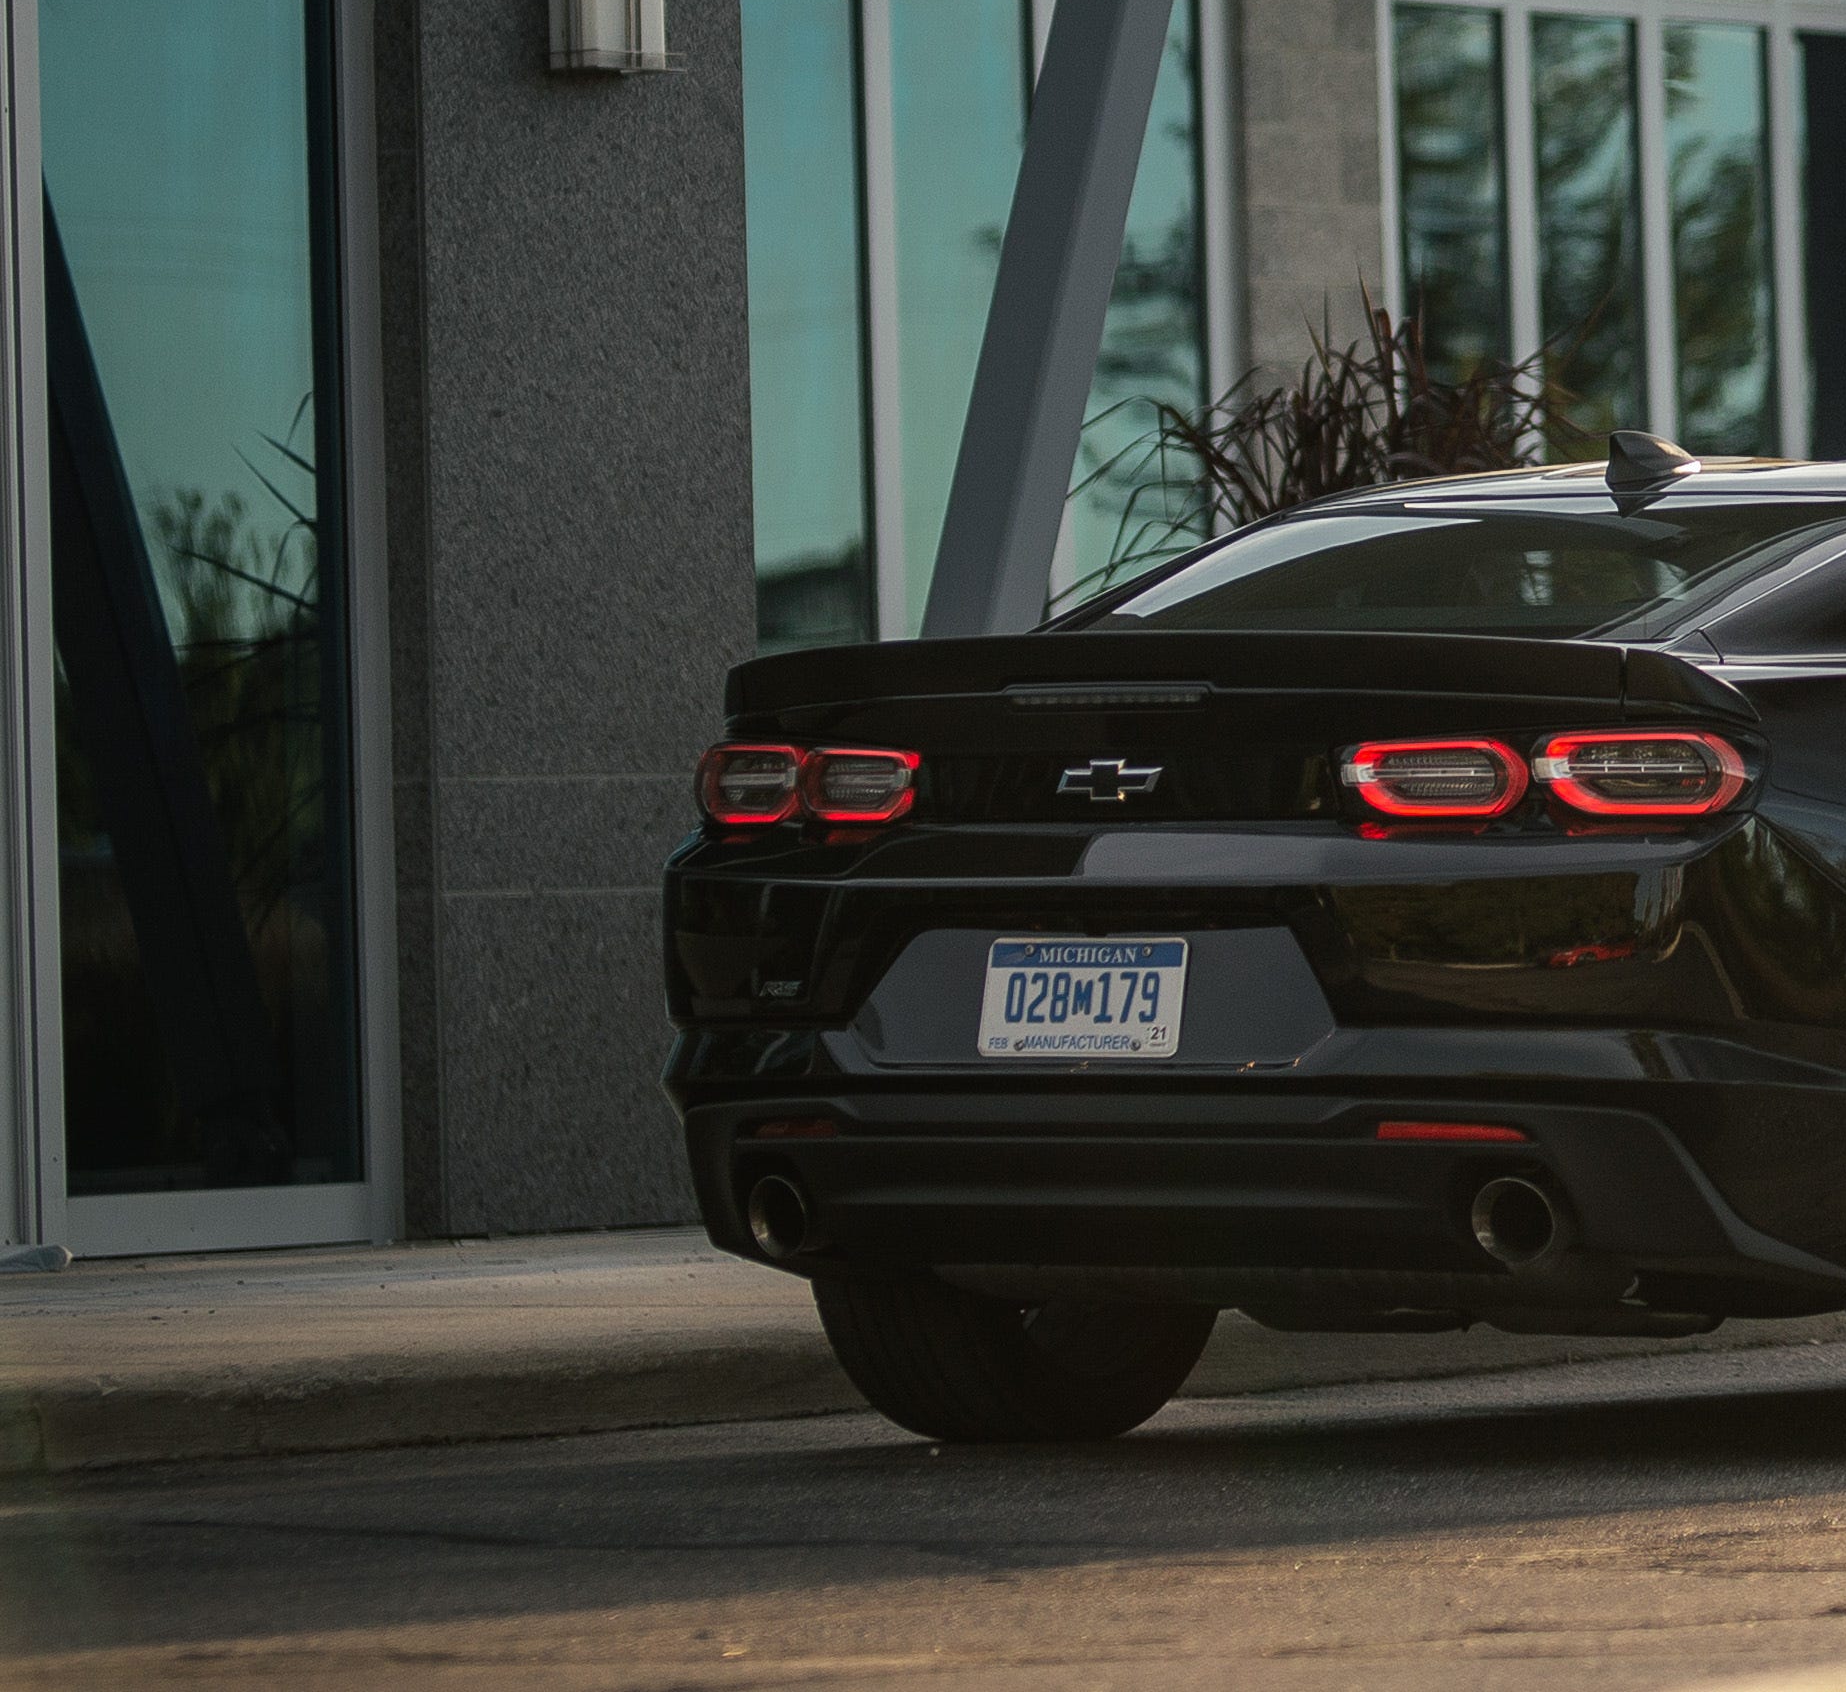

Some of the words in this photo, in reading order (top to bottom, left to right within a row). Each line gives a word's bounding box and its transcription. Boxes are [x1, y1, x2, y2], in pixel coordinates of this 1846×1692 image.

[1039, 946, 1138, 964] MICHIGAN
[1004, 971, 1160, 1024] 028M179
[988, 1037, 1009, 1049] FEB
[1022, 1034, 1131, 1050] MANUFACTURER
